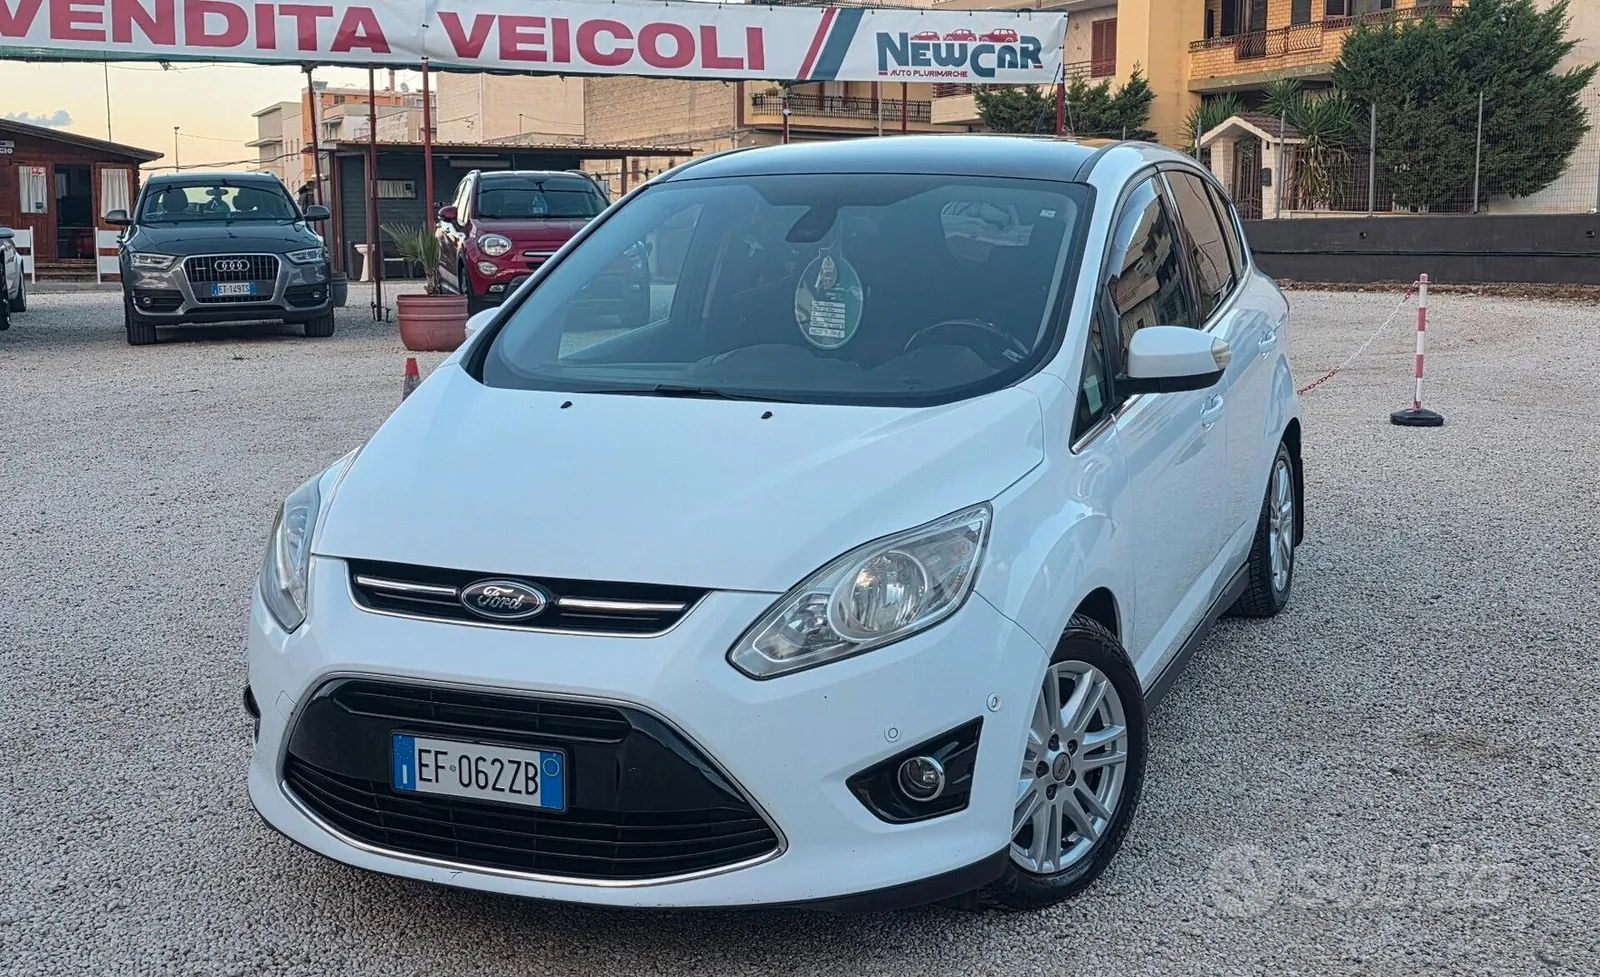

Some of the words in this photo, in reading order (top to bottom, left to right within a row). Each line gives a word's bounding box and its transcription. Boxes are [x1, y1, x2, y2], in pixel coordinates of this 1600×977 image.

[0, 0, 392, 54] VENDITA
[437, 11, 766, 70] VEICOLI
[890, 69, 912, 77] AUTO
[912, 69, 968, 78] PLURIMARCHE
[477, 586, 525, 612] Ford
